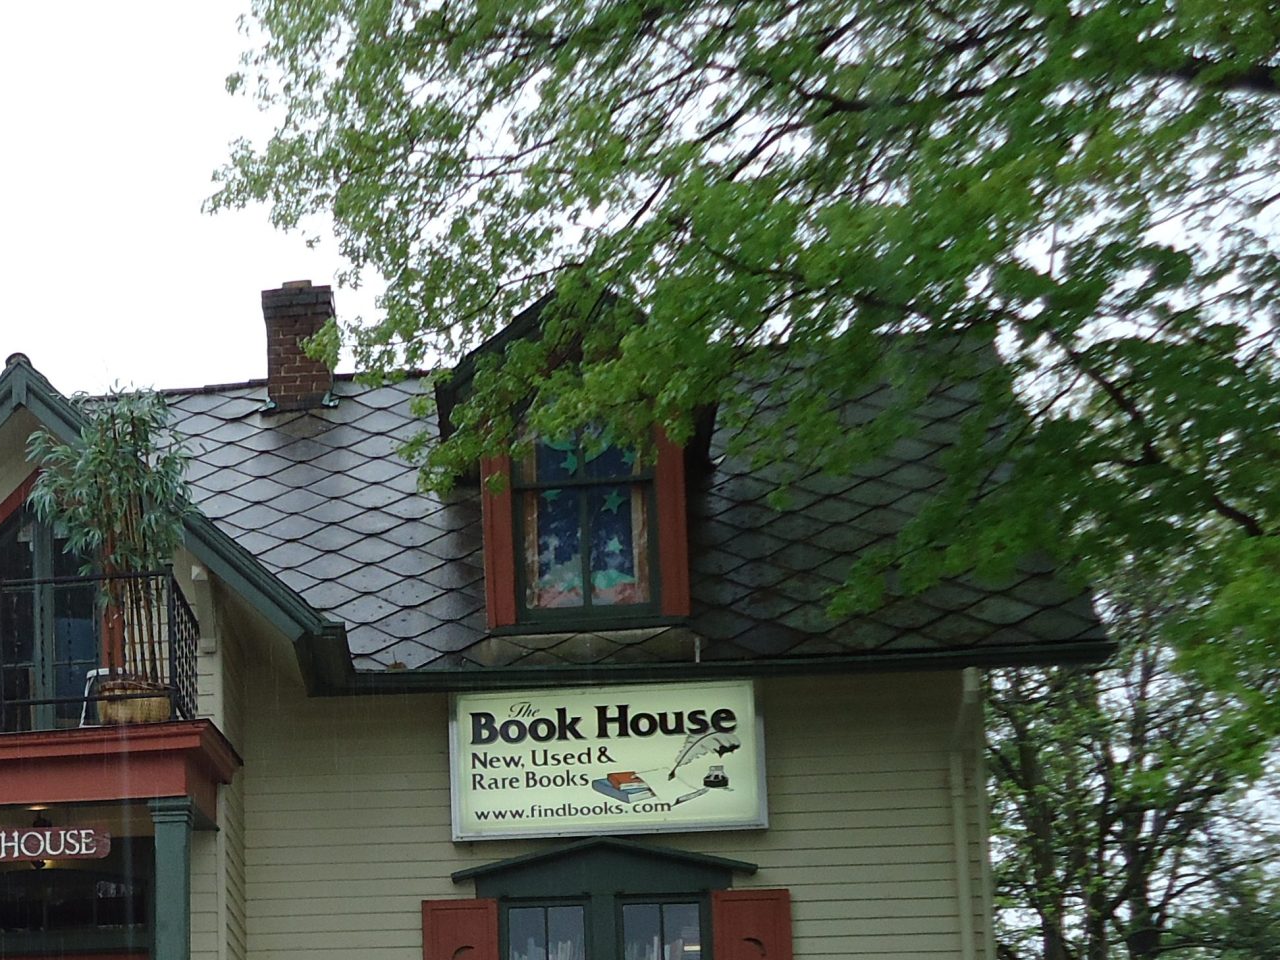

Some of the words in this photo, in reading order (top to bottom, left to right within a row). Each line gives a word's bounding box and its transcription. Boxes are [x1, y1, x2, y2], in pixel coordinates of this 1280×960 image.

[508, 701, 541, 719] The
[469, 707, 585, 745] Book
[594, 703, 737, 739] House
[471, 752, 525, 770] New,
[531, 748, 593, 766] Used
[596, 746, 617, 764] &
[471, 773, 521, 791] Rare
[525, 770, 590, 789] Books
[0, 829, 97, 859] HOUSE
